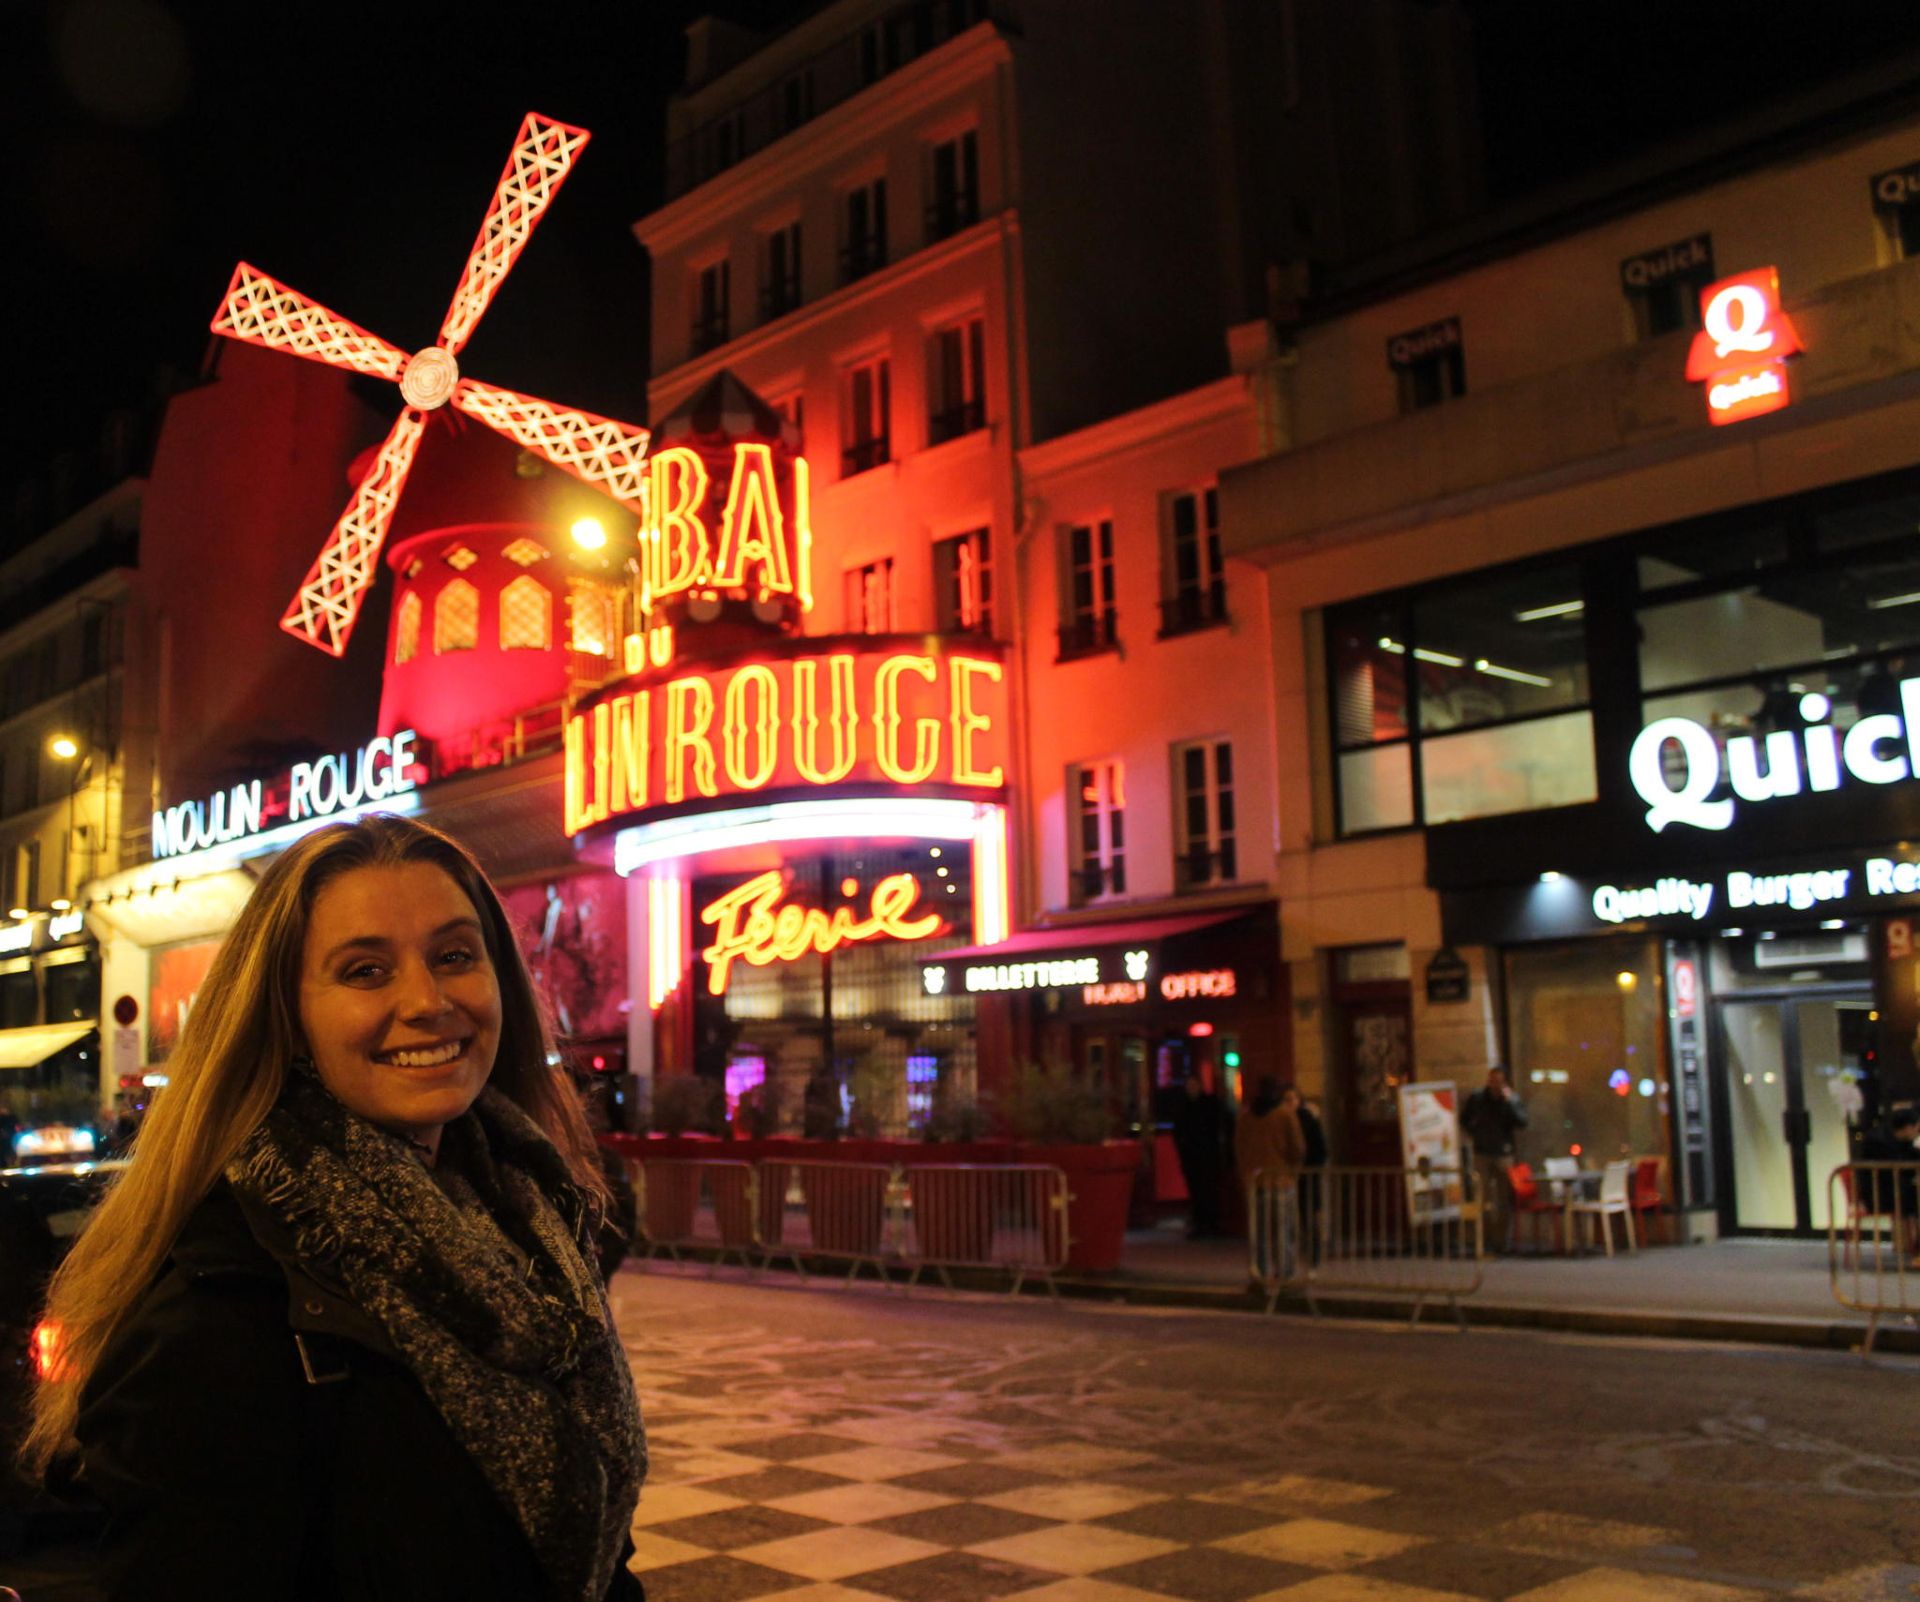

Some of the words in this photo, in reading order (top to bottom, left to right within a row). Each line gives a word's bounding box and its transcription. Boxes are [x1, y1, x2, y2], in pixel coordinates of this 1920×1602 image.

[1623, 239, 1710, 288] Quick
[1704, 284, 1775, 359] Q
[665, 655, 1004, 803] ROUGE
[153, 779, 262, 858] MOULIN
[289, 729, 417, 822] ROUGE
[1592, 877, 1714, 923] Quality
[1726, 870, 1851, 910] Burger
[1866, 858, 1920, 896] Re
